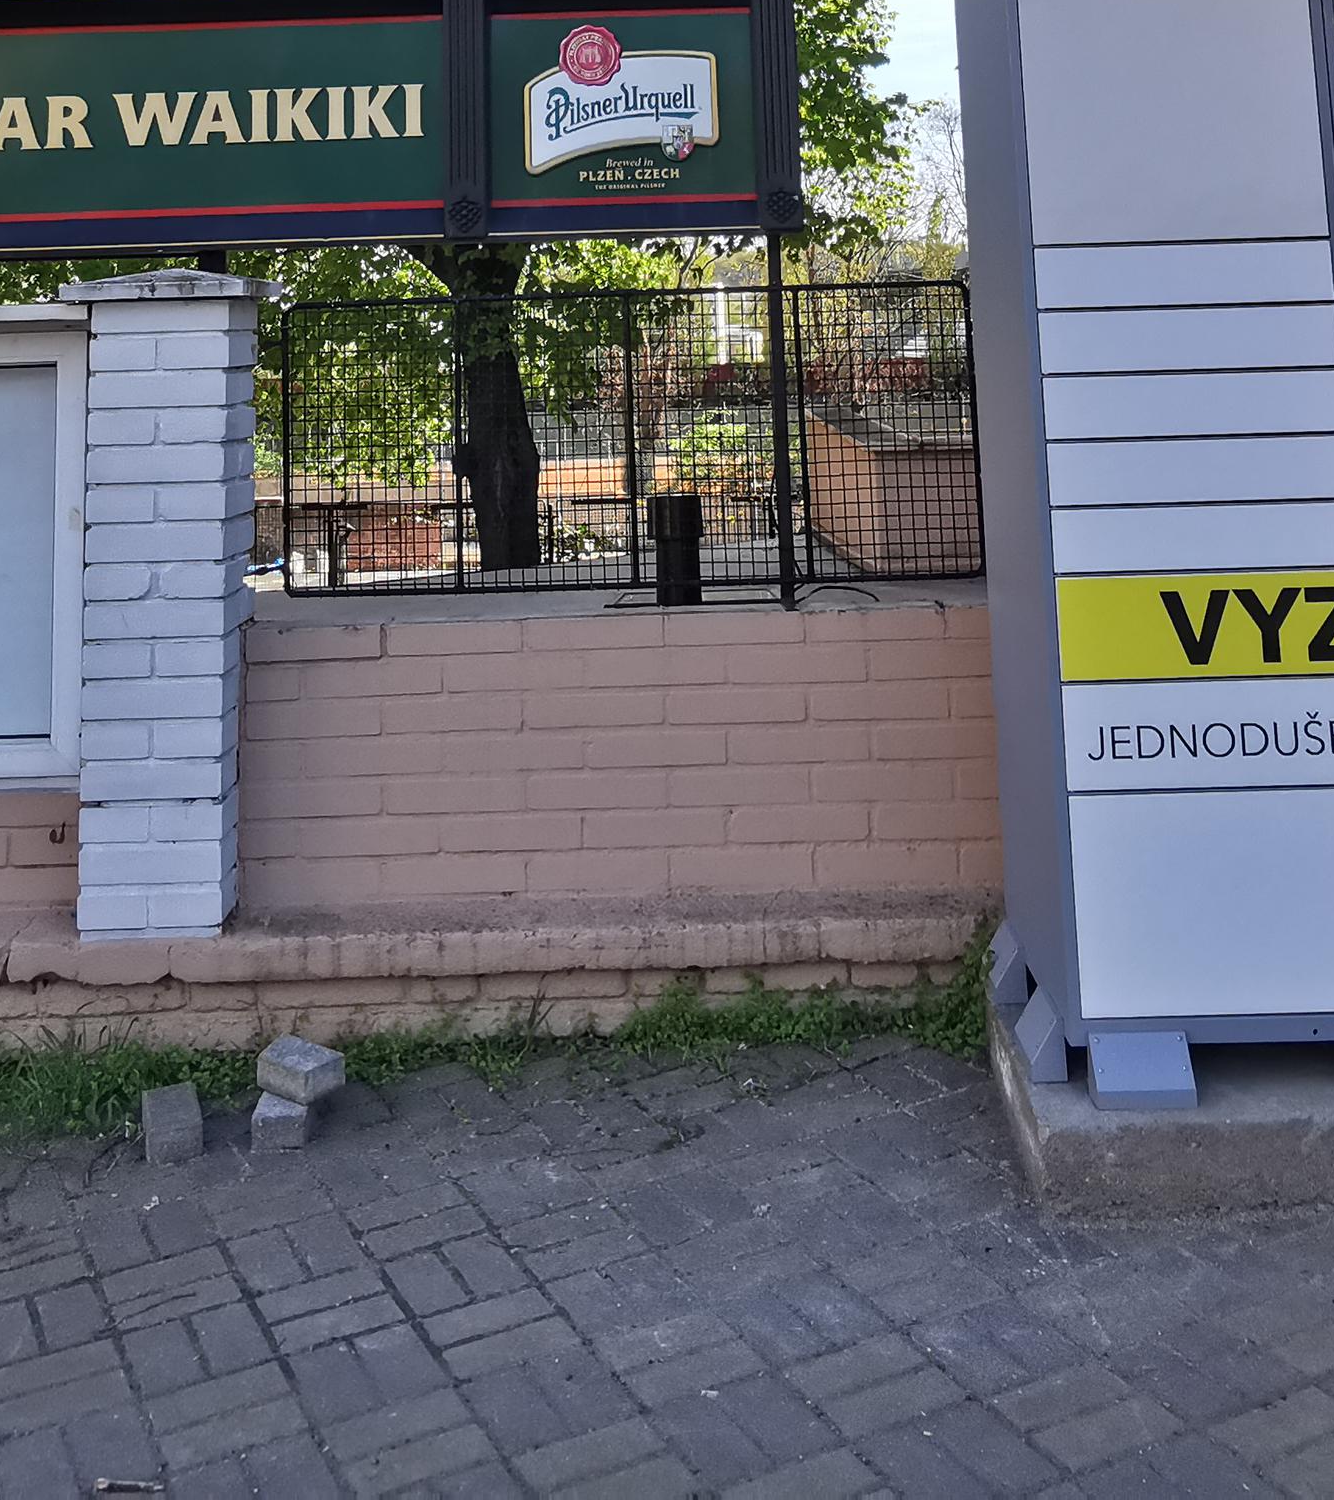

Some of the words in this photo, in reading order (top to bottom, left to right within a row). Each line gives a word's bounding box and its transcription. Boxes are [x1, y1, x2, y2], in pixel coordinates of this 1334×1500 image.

[111, 83, 425, 147] WAIKIKI
[545, 87, 622, 141] Pilsner
[620, 83, 695, 122] Urquell
[606, 157, 641, 168] Brewed
[643, 158, 654, 167] in
[634, 168, 680, 180] CZECH
